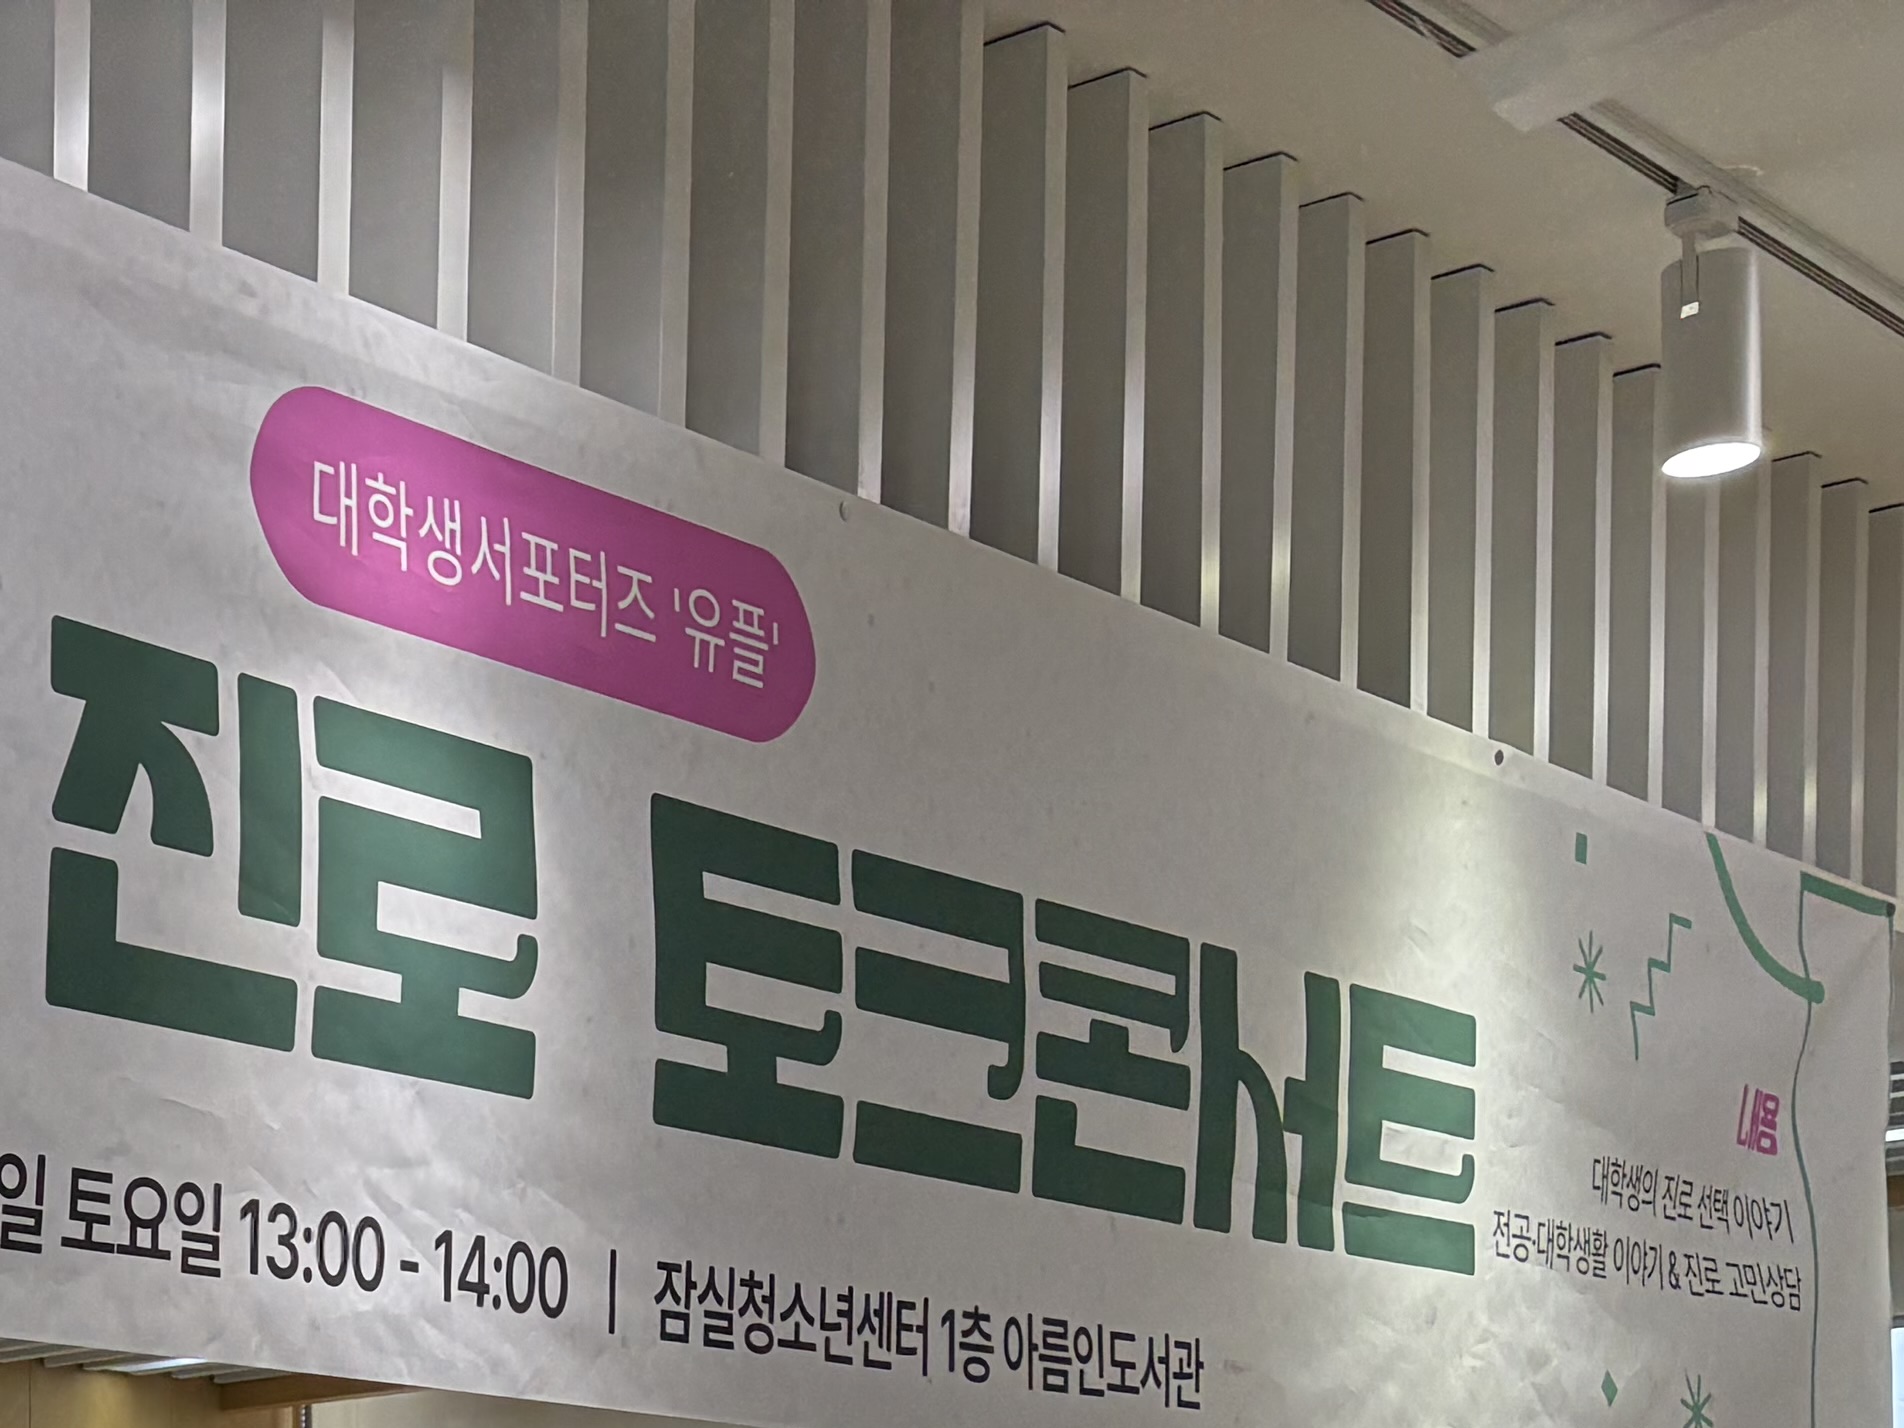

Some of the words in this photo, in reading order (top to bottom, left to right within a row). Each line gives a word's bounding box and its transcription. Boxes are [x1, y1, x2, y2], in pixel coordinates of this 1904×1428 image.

[312, 460, 657, 643] 대학생서포터즈
[46, 614, 540, 1099] 진로
[651, 792, 1479, 1276] 토크콘서트
[1735, 1082, 1780, 1156] 내용
[1591, 1155, 1659, 1217] 대학생의
[1661, 1174, 1694, 1222] 진로
[1697, 1184, 1731, 1235] 선택
[1732, 1193, 1794, 1244] 이야기
[60, 1168, 223, 1277] 토요일
[239, 1198, 385, 1294] 13:00
[434, 1228, 569, 1319] 14:00
[653, 1259, 930, 1377] 잠실청소년센터
[940, 1305, 994, 1384] 1층
[1003, 1312, 1205, 1411] 아름인도서관
[1612, 1235, 1664, 1291] 이야기
[1668, 1250, 1682, 1291] &
[1684, 1252, 1725, 1297] 진로
[1725, 1261, 1802, 1312] 고민상담
